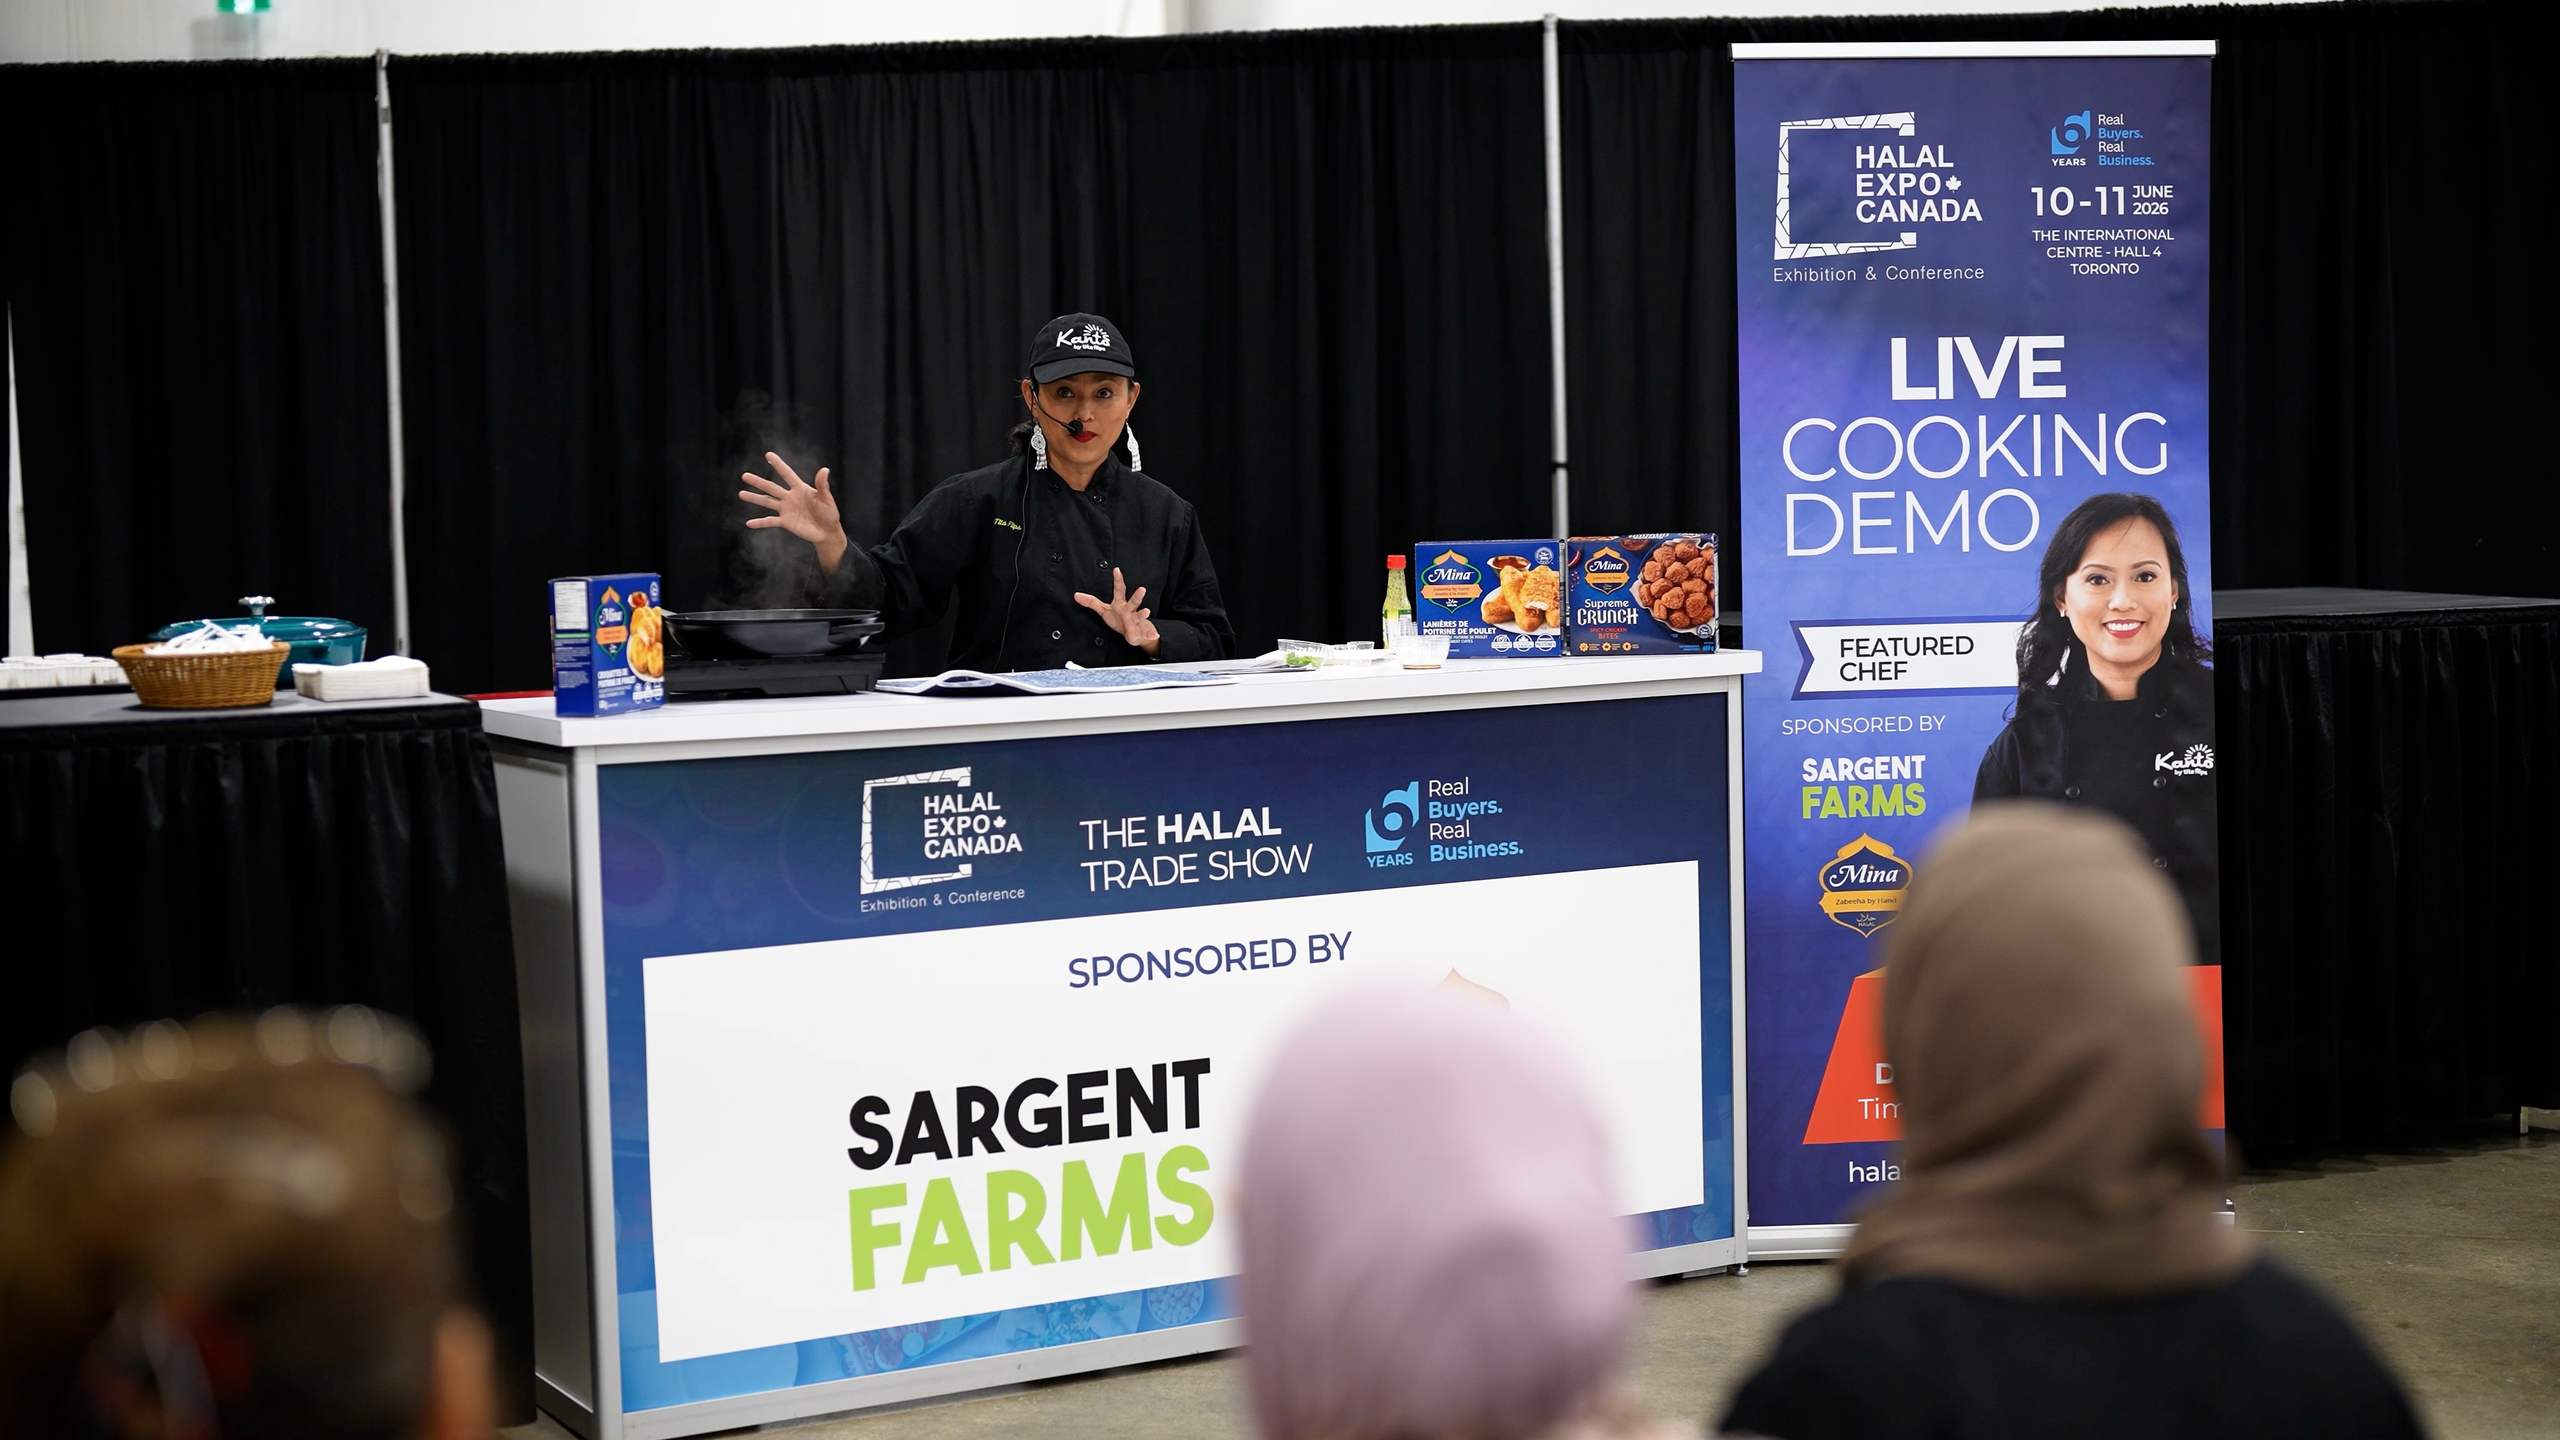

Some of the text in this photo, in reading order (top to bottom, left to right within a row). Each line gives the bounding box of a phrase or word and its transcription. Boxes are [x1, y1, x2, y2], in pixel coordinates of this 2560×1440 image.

[2098, 113, 2125, 125] Real
[2098, 127, 2143, 141] Buyers.
[1856, 145, 1954, 168] HALAL
[2098, 140, 2125, 152] Real
[2052, 158, 2087, 166] YEARS
[2098, 154, 2154, 166] Business.
[1856, 172, 1942, 197] EXPO
[2132, 185, 2174, 198] JUNE
[1856, 199, 1983, 223] CANADA
[2132, 202, 2169, 215] 2026
[2032, 229, 2175, 241] THE INTERNATIONAL
[2046, 247, 2103, 258] CENTRE
[2114, 246, 2150, 258] HALL
[2152, 246, 2162, 257] 4
[1774, 265, 1985, 282] Exhibition & Conference
[2070, 263, 2139, 275] TORONTO
[1891, 335, 2067, 401] LIVE
[1782, 412, 2168, 482] COOKING
[1786, 488, 2040, 557] DEMO
[1428, 568, 1472, 582] Mina
[1589, 560, 1625, 572] Mina
[1584, 598, 1630, 609] Supreme
[1422, 619, 1469, 628] LANIÈRES DE
[1577, 608, 1639, 626] CRUNCH
[1469, 627, 1497, 635] POULET
[1598, 632, 1619, 640] BITES
[1840, 636, 1974, 658] FEATURED
[1839, 661, 1908, 682] CHEF
[1782, 715, 1946, 735] SPONSORED BY
[1802, 755, 1926, 782] SARGENT
[2155, 751, 2214, 771] Kanto
[1428, 776, 1469, 797] Real
[924, 791, 1001, 815] HALAL
[1428, 799, 1503, 821] Buyers.
[1802, 783, 1927, 819] FARMS
[924, 814, 991, 838] EXPO
[1079, 806, 1282, 850] THE HALAL
[1429, 819, 1470, 840] Real
[924, 833, 1023, 860] CANADA
[1429, 840, 1524, 862] Business.
[1080, 843, 1313, 892] TRADE SHOW
[1366, 852, 1414, 868] YEARS
[1829, 864, 1900, 887] Mina
[860, 888, 1025, 912] Exhibition & Conference
[1835, 897, 1866, 906] Zabeeha
[1867, 897, 1877, 906] by
[1069, 931, 1353, 989] SPONSORED BY
[847, 1057, 1211, 1171] SARGENT
[1857, 1097, 1903, 1119] Tim
[1849, 1160, 1905, 1183] hala
[848, 1145, 1215, 1292] FARMS
